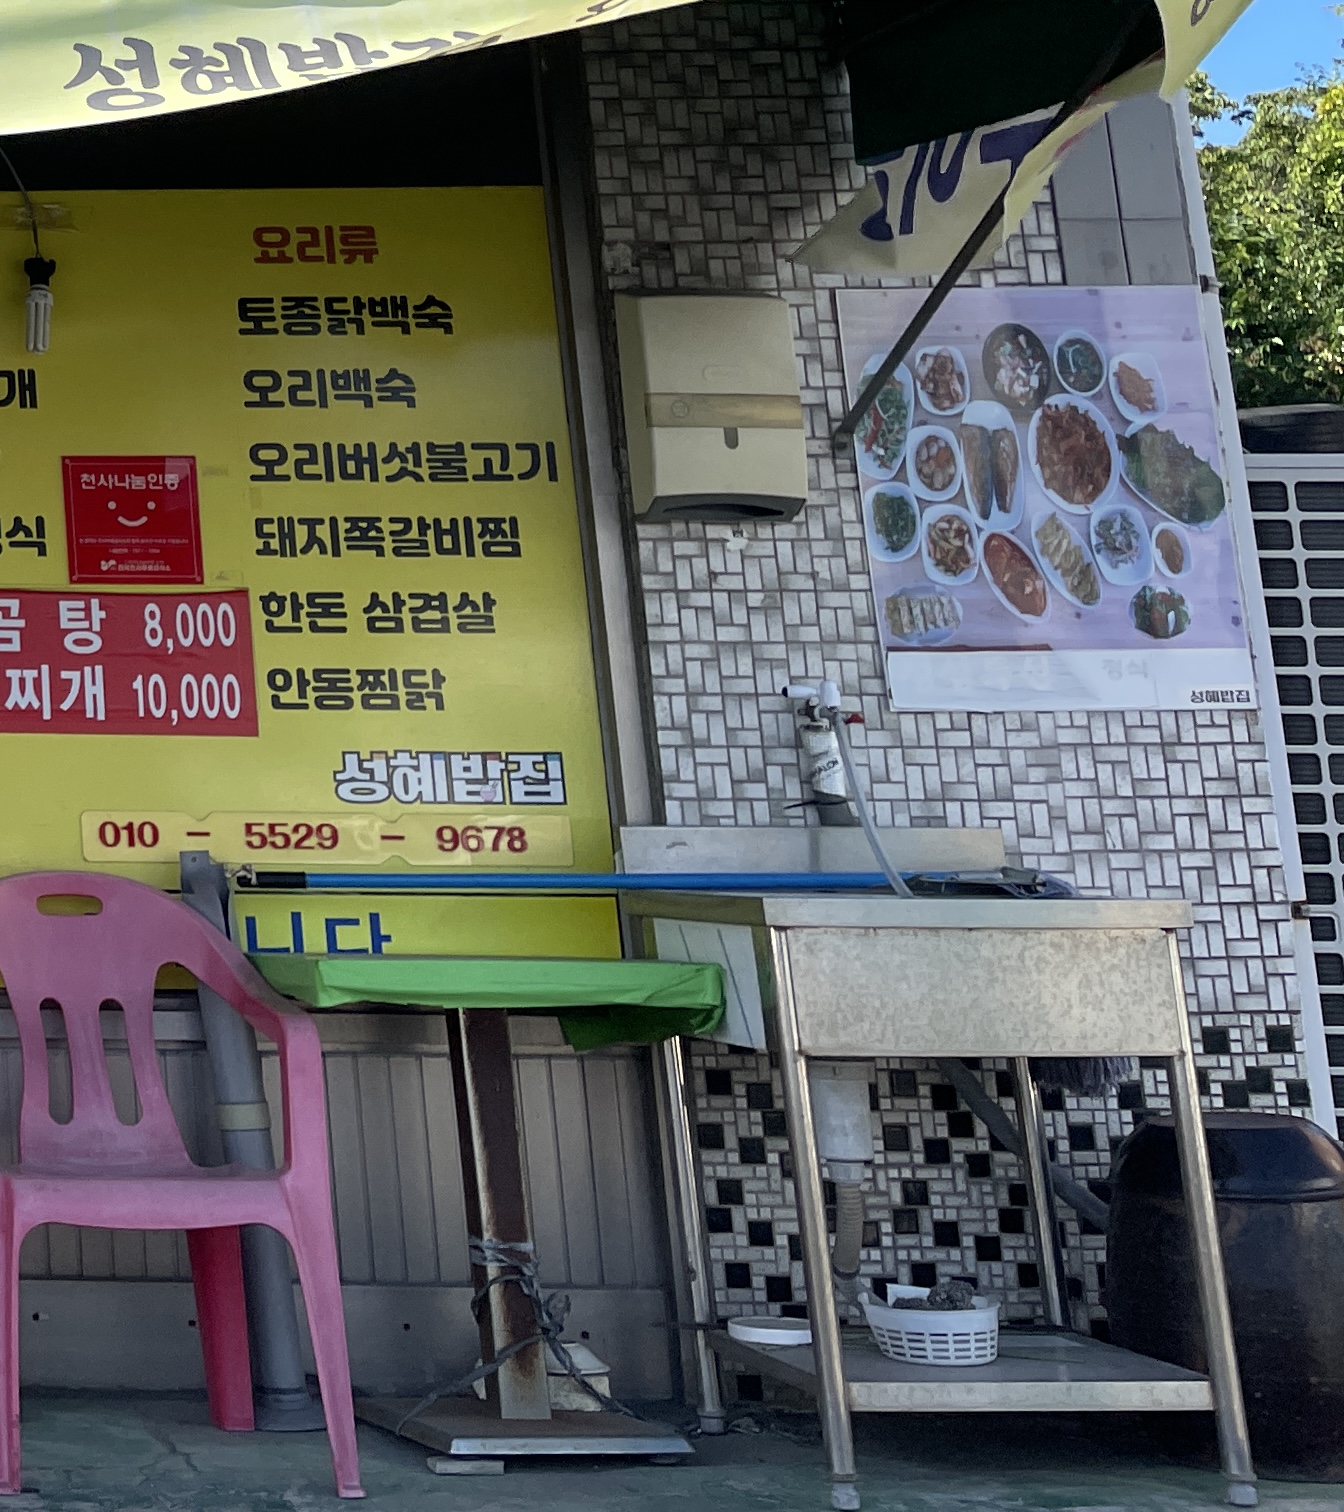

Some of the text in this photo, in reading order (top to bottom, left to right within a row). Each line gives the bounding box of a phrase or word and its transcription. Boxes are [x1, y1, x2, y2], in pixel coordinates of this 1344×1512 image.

[253, 225, 379, 265] 요리류
[237, 295, 454, 336] 토종닭백숙
[243, 368, 417, 409] 오리백숙
[248, 440, 559, 483] 오리버섯불고기
[255, 515, 523, 558] 돼지쪽갈비찜
[143, 602, 237, 656] 8,000
[258, 591, 497, 635] 한돈 삼겹살
[131, 672, 242, 726] 10,000
[266, 667, 447, 711] 안동찜닭
[1189, 689, 1252, 704] 성혜밥집
[333, 750, 568, 805] 성혜밥집
